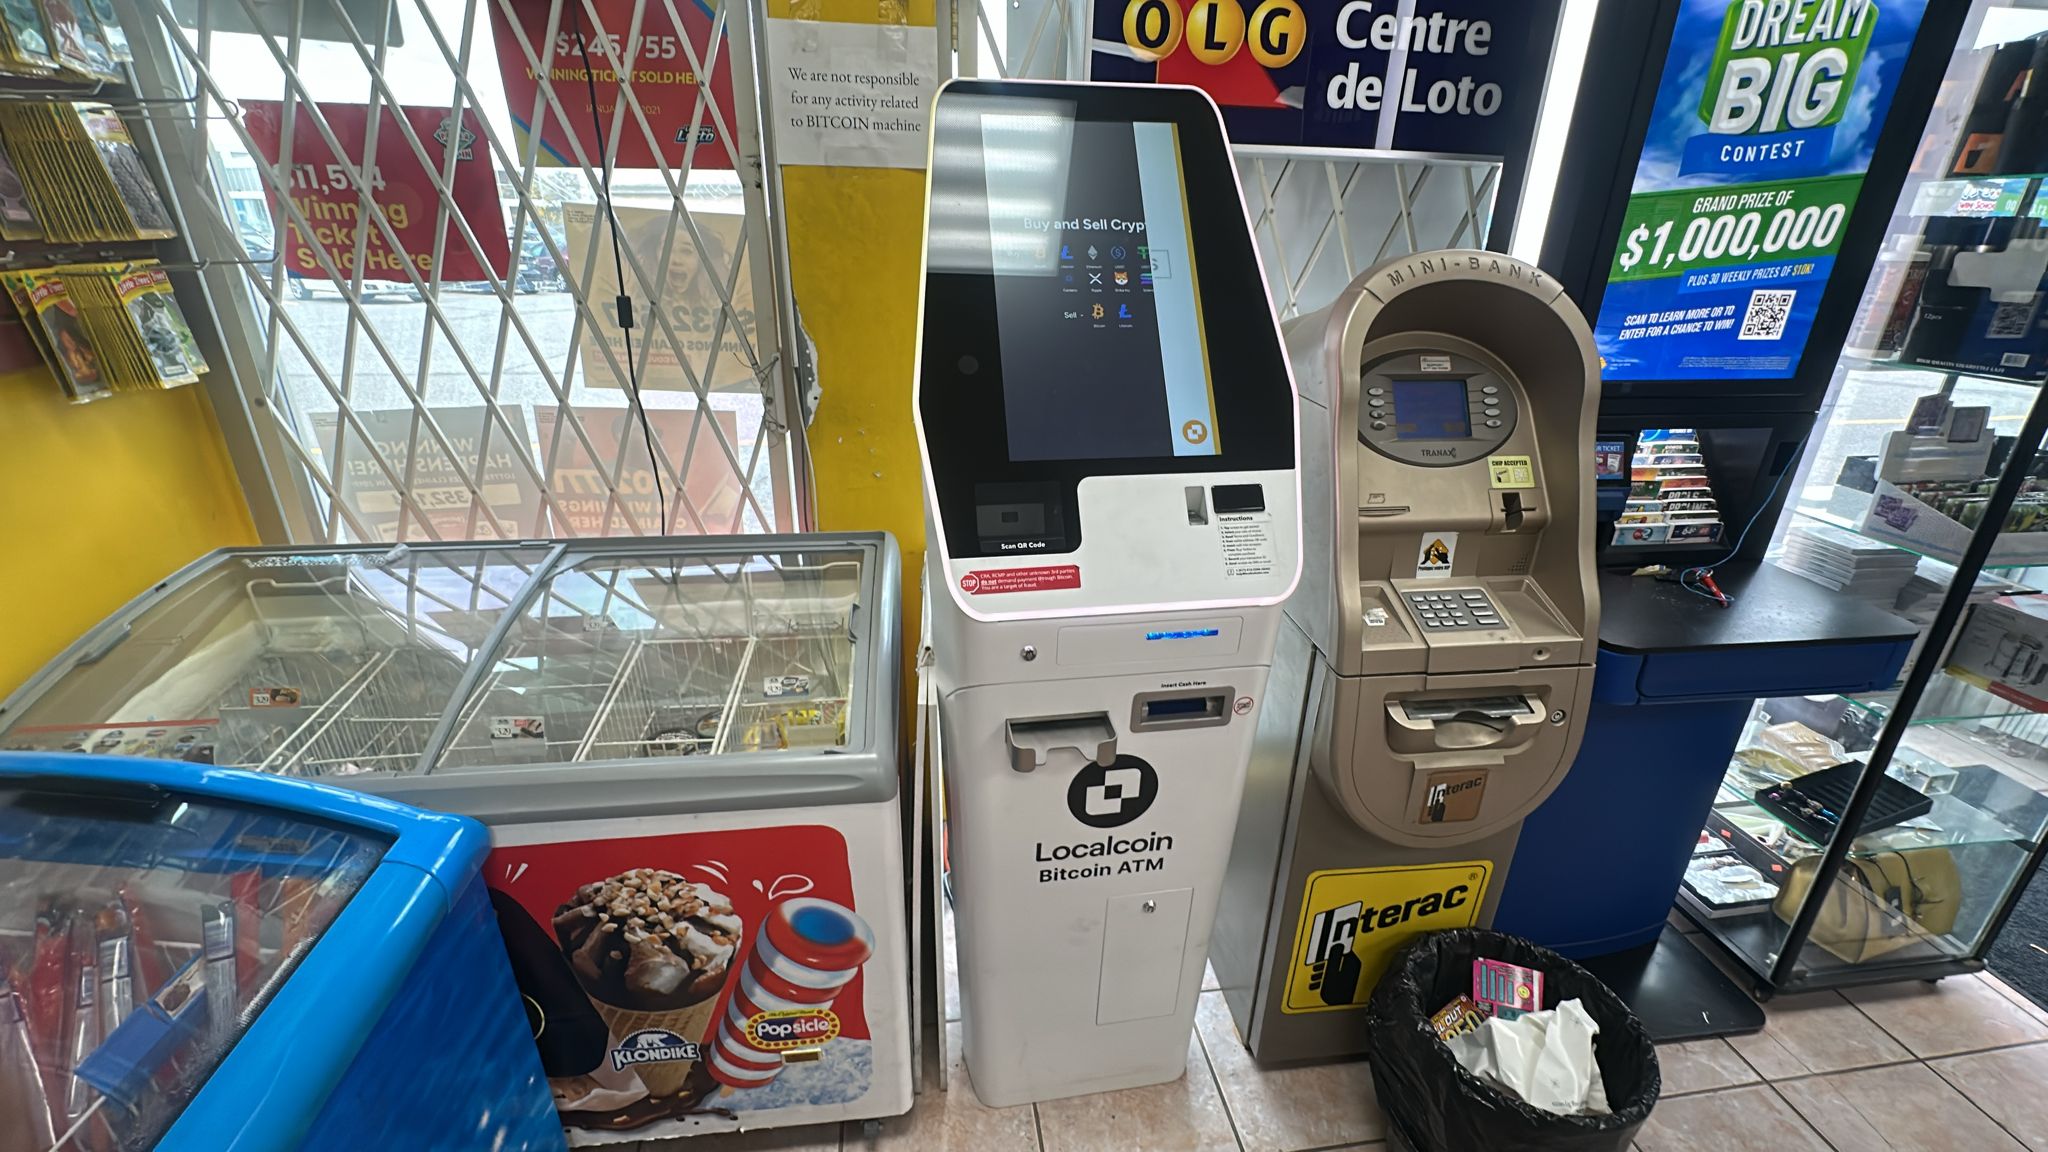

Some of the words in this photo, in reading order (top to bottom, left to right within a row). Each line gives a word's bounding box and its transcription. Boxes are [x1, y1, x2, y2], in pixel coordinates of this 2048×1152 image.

[1135, 0, 1292, 55] OLG
[1336, 0, 1491, 56] Centre
[1731, 0, 1872, 50] DREAM
[639, 70, 674, 83] SOLD
[788, 66, 807, 81] We
[810, 73, 828, 82] are
[831, 72, 851, 83] not
[854, 73, 920, 89] responsible
[791, 90, 809, 105] for
[811, 96, 831, 109] any
[835, 95, 877, 112] activity
[880, 96, 919, 110] related
[1327, 62, 1381, 111] de
[1402, 67, 1502, 117] Loto
[1708, 47, 1848, 135] BIG
[791, 117, 803, 128] to
[806, 116, 869, 130] BITCOIN
[873, 118, 921, 132] machine
[1720, 140, 1805, 163] CONTEST
[1693, 197, 1736, 214] GRAND
[1737, 192, 1775, 210] PRIZE
[1775, 190, 1795, 207] OF
[1024, 218, 1050, 233] Buy
[1054, 218, 1080, 231] and
[1082, 218, 1108, 231] Sell
[1619, 203, 1846, 272] $1,000,000
[134, 274, 151, 287] Trees
[1386, 256, 1543, 287] MINI-BANK
[1687, 275, 1708, 287] PLUS
[1708, 274, 1719, 286] 30
[1720, 270, 1751, 283] WEEKLY
[1751, 267, 1780, 281] PRIZES
[1780, 266, 1792, 278] OF
[1063, 311, 1078, 319] Sell
[1624, 315, 1647, 327] SCAN
[1647, 313, 1659, 325] TO
[1658, 309, 1685, 323] LEARN
[1685, 307, 1712, 320] MORE
[1711, 306, 1724, 317] OR
[1723, 305, 1735, 316] TO
[1619, 328, 1646, 340] ENTER
[1646, 326, 1664, 337] FOR
[1663, 325, 1670, 335] A
[1670, 322, 1702, 335] CHANCE
[1702, 321, 1714, 331] TO
[1714, 318, 1735, 330] WIN!
[1421, 449, 1453, 457] TRANAX
[962, 579, 977, 587] STOP
[1427, 777, 1482, 806] Interac
[1035, 831, 1174, 862] Localcoin
[1039, 863, 1112, 883] Bitcoin
[1117, 857, 1164, 875] ATM
[1315, 885, 1469, 960] Interac
[757, 1018, 829, 1038] Popsicle
[613, 1044, 698, 1070] KLONDIKE
